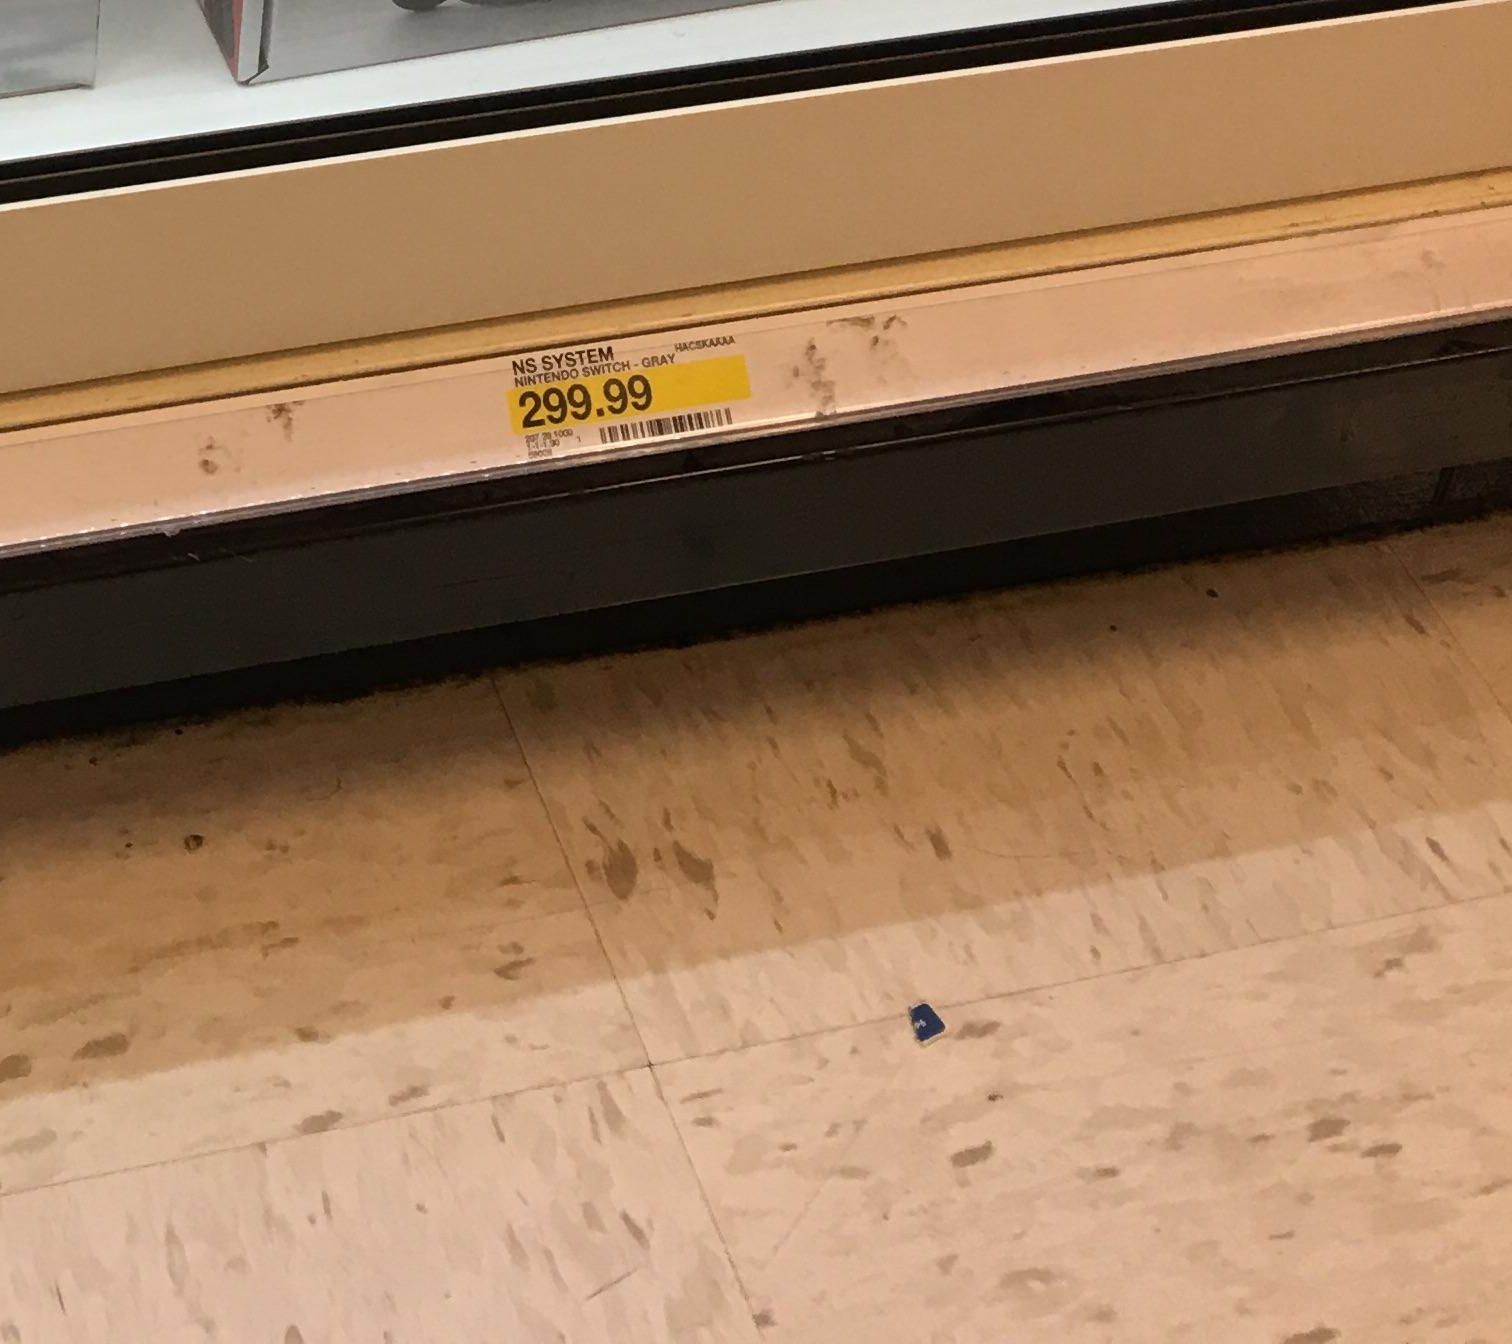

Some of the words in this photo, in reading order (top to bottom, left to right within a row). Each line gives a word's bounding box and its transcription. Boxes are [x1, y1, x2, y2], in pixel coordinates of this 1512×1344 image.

[511, 357, 538, 375] NS
[541, 346, 614, 371] SYSTEM
[514, 368, 579, 387] NINTENDO
[582, 360, 631, 377] SWITCH
[641, 353, 676, 368] GRAY
[518, 374, 653, 429] 299.99
